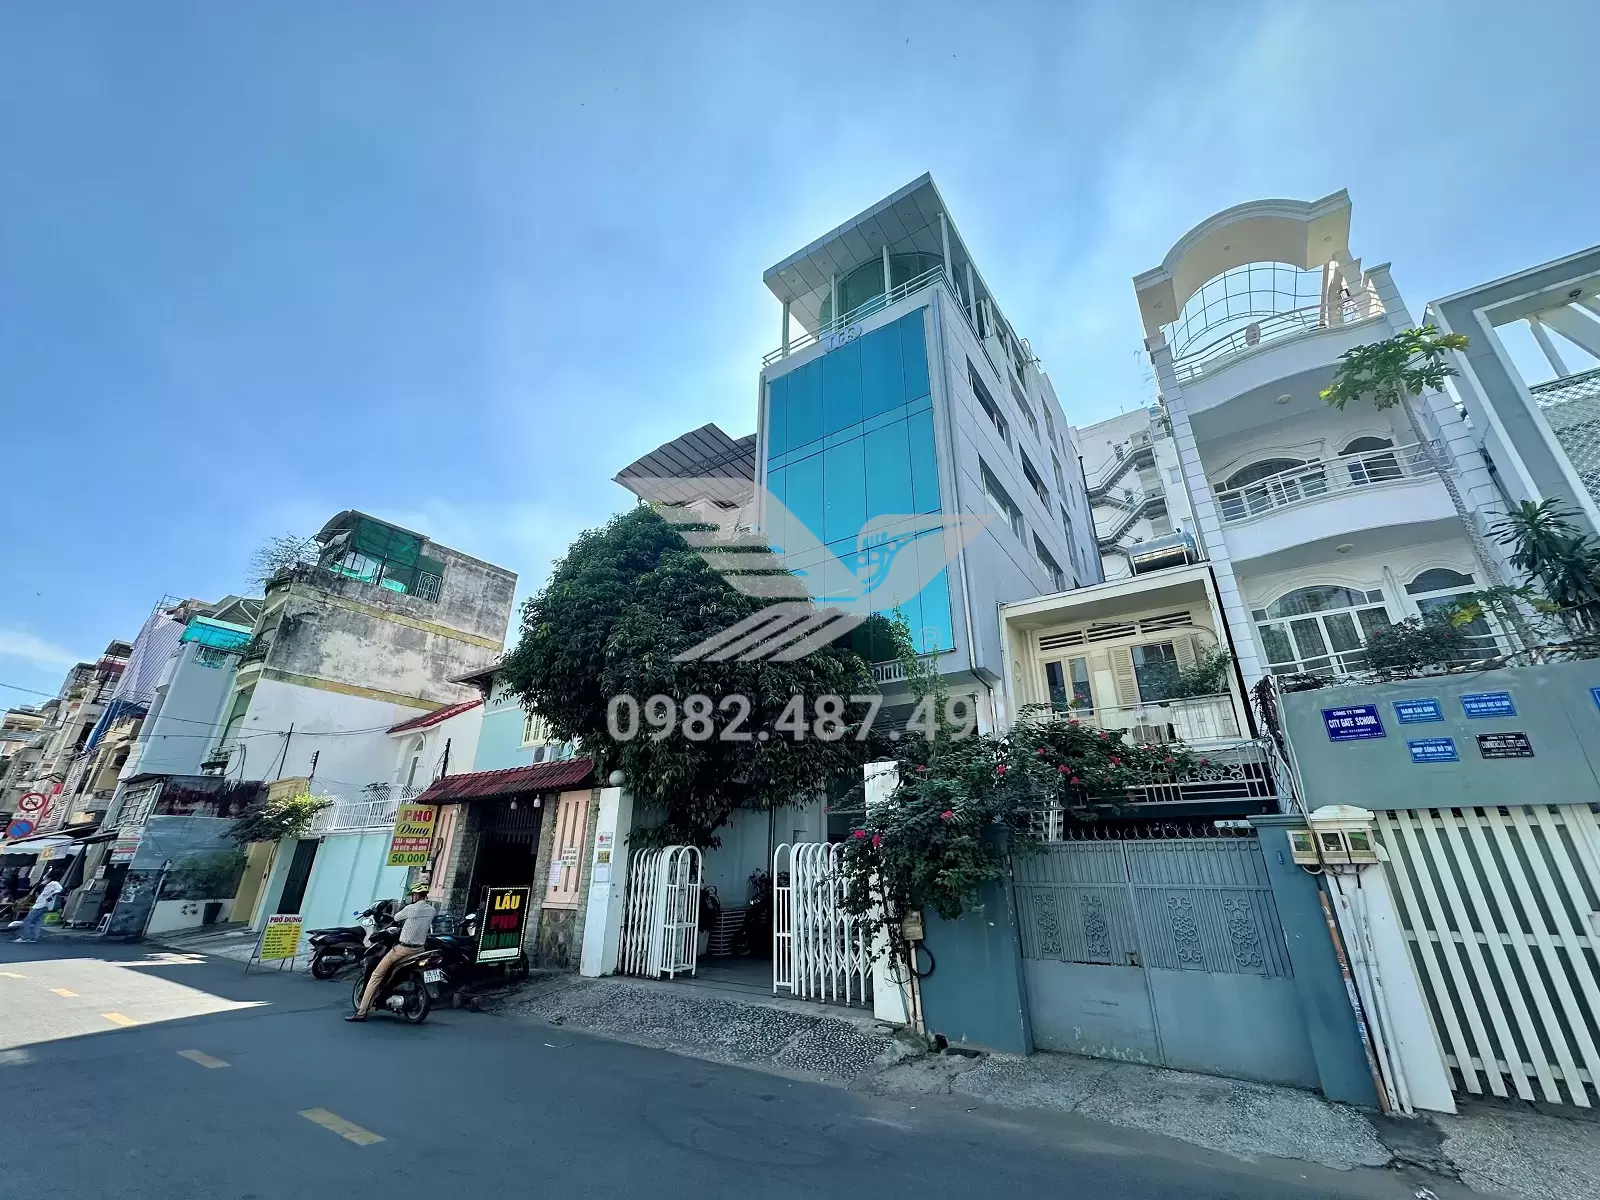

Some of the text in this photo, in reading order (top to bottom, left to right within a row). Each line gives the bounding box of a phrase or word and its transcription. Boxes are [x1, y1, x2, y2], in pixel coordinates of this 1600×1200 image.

[1328, 716, 1377, 728] CITY GATE SCHOOL
[402, 807, 433, 822] PHỞ
[397, 823, 430, 837] Dung
[391, 854, 425, 863] 50.000
[495, 890, 520, 910] LẨU
[270, 915, 284, 923] PHỞ
